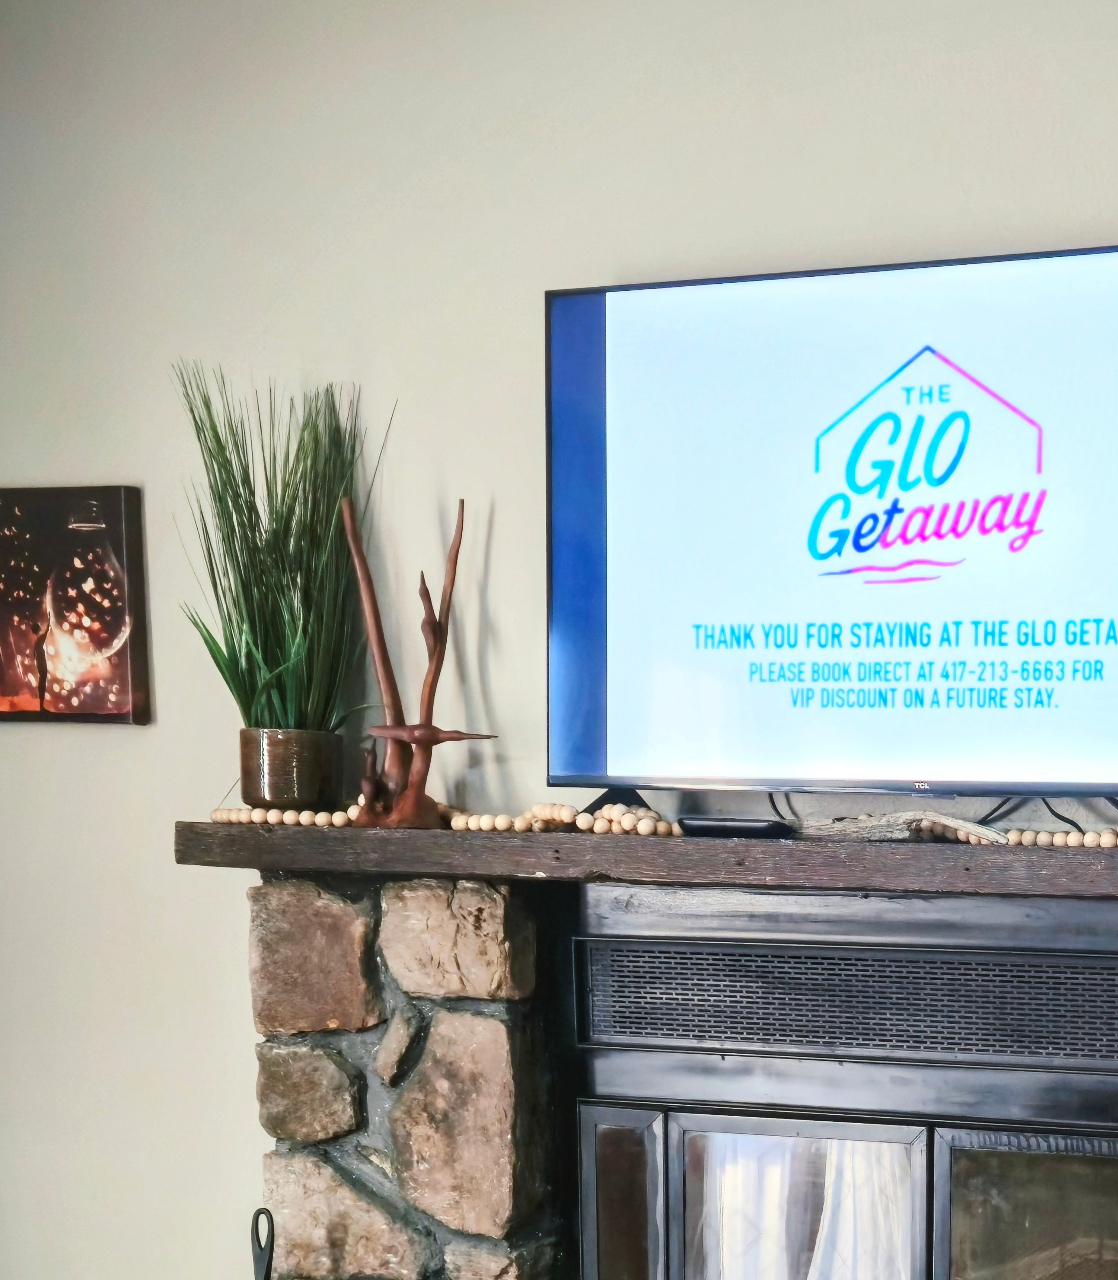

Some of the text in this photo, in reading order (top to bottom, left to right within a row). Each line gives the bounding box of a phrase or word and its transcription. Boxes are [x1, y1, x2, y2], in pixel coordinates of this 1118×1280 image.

[901, 383, 951, 406] THE
[806, 488, 1048, 561] Getaway
[691, 623, 756, 650] THANK
[760, 622, 799, 650] YOU
[805, 621, 844, 649] FOR
[849, 621, 932, 649] STAYING
[938, 620, 964, 648] AT
[970, 619, 1010, 648] THE
[1015, 618, 1057, 648] GLO
[748, 658, 1105, 683] PLEASE BOOK DIRECT AT 417-213-6663 FOR
[790, 686, 1059, 710] VIP DISCOUNT ON A FUTURE STAY.
